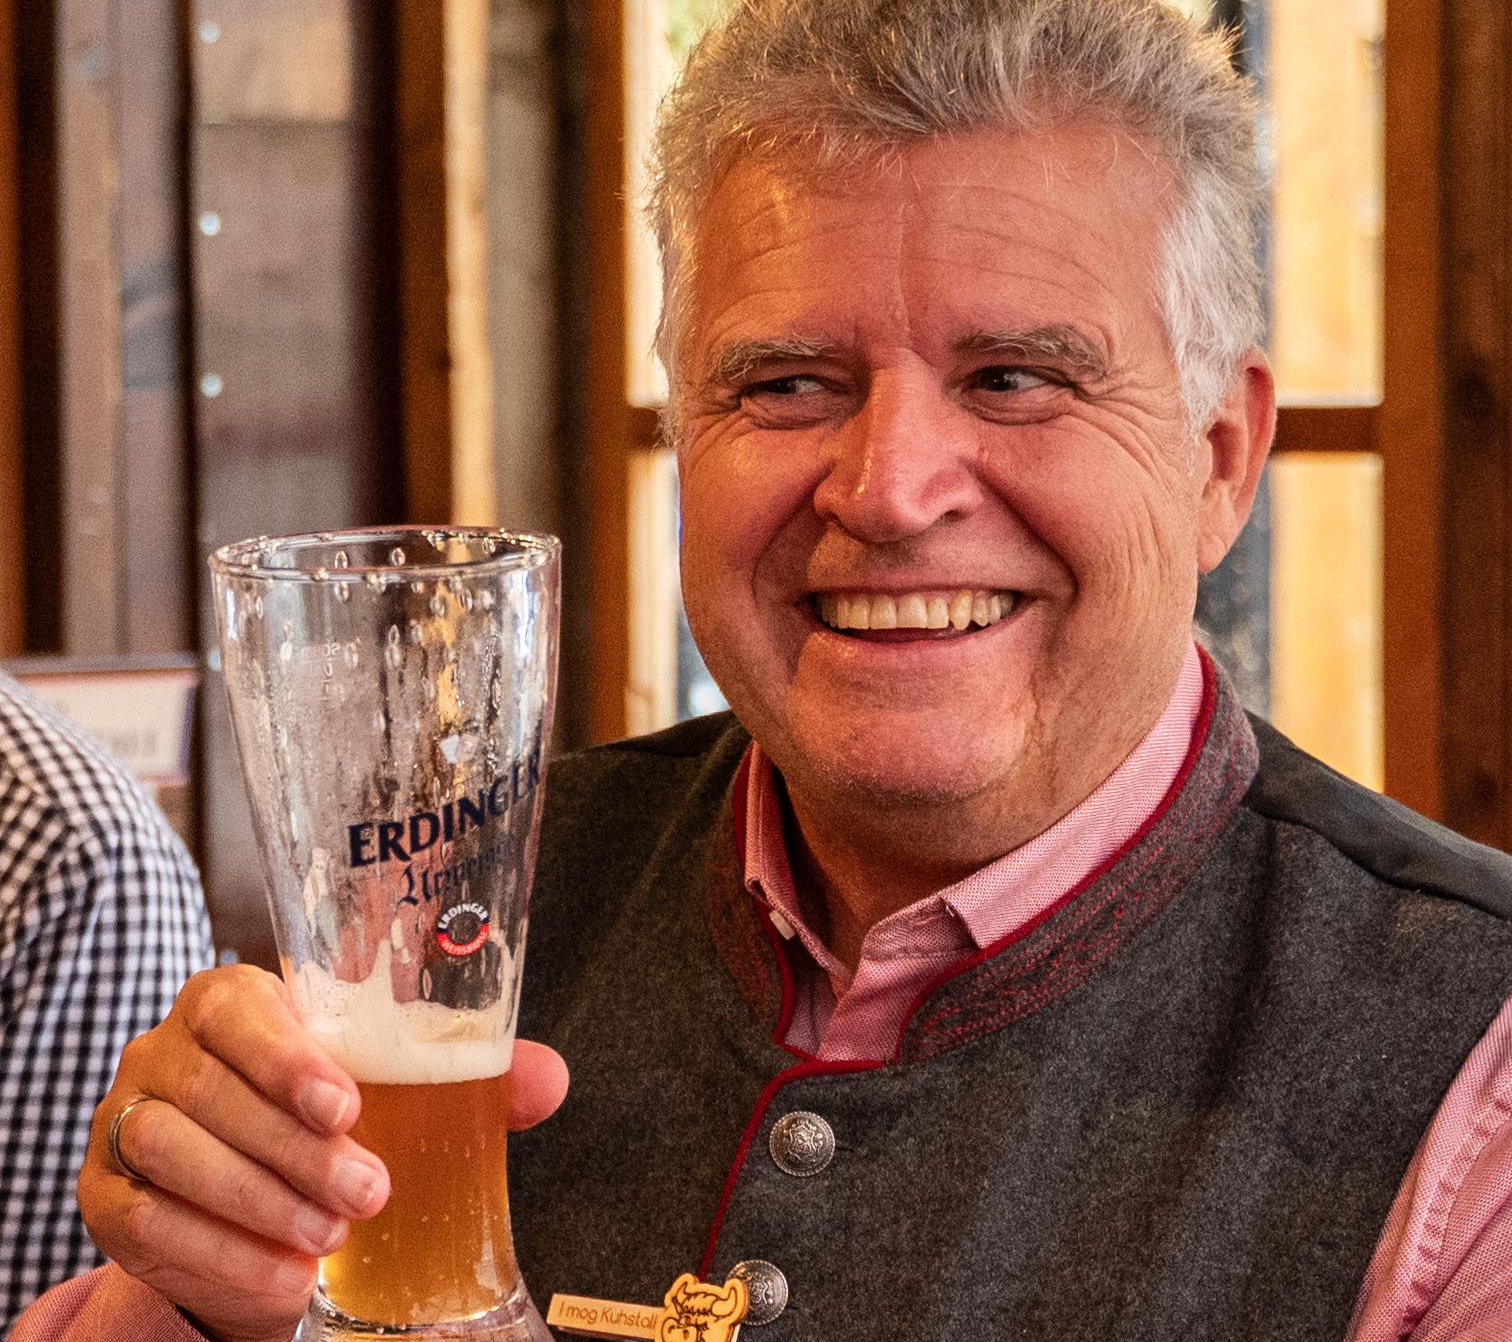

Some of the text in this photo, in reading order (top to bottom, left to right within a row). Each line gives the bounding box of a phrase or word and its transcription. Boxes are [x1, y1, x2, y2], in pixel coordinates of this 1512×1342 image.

[347, 735, 541, 868] ERDINGER
[437, 902, 489, 930] ERDINGER
[558, 1301, 658, 1331] I mog Kuhstall
